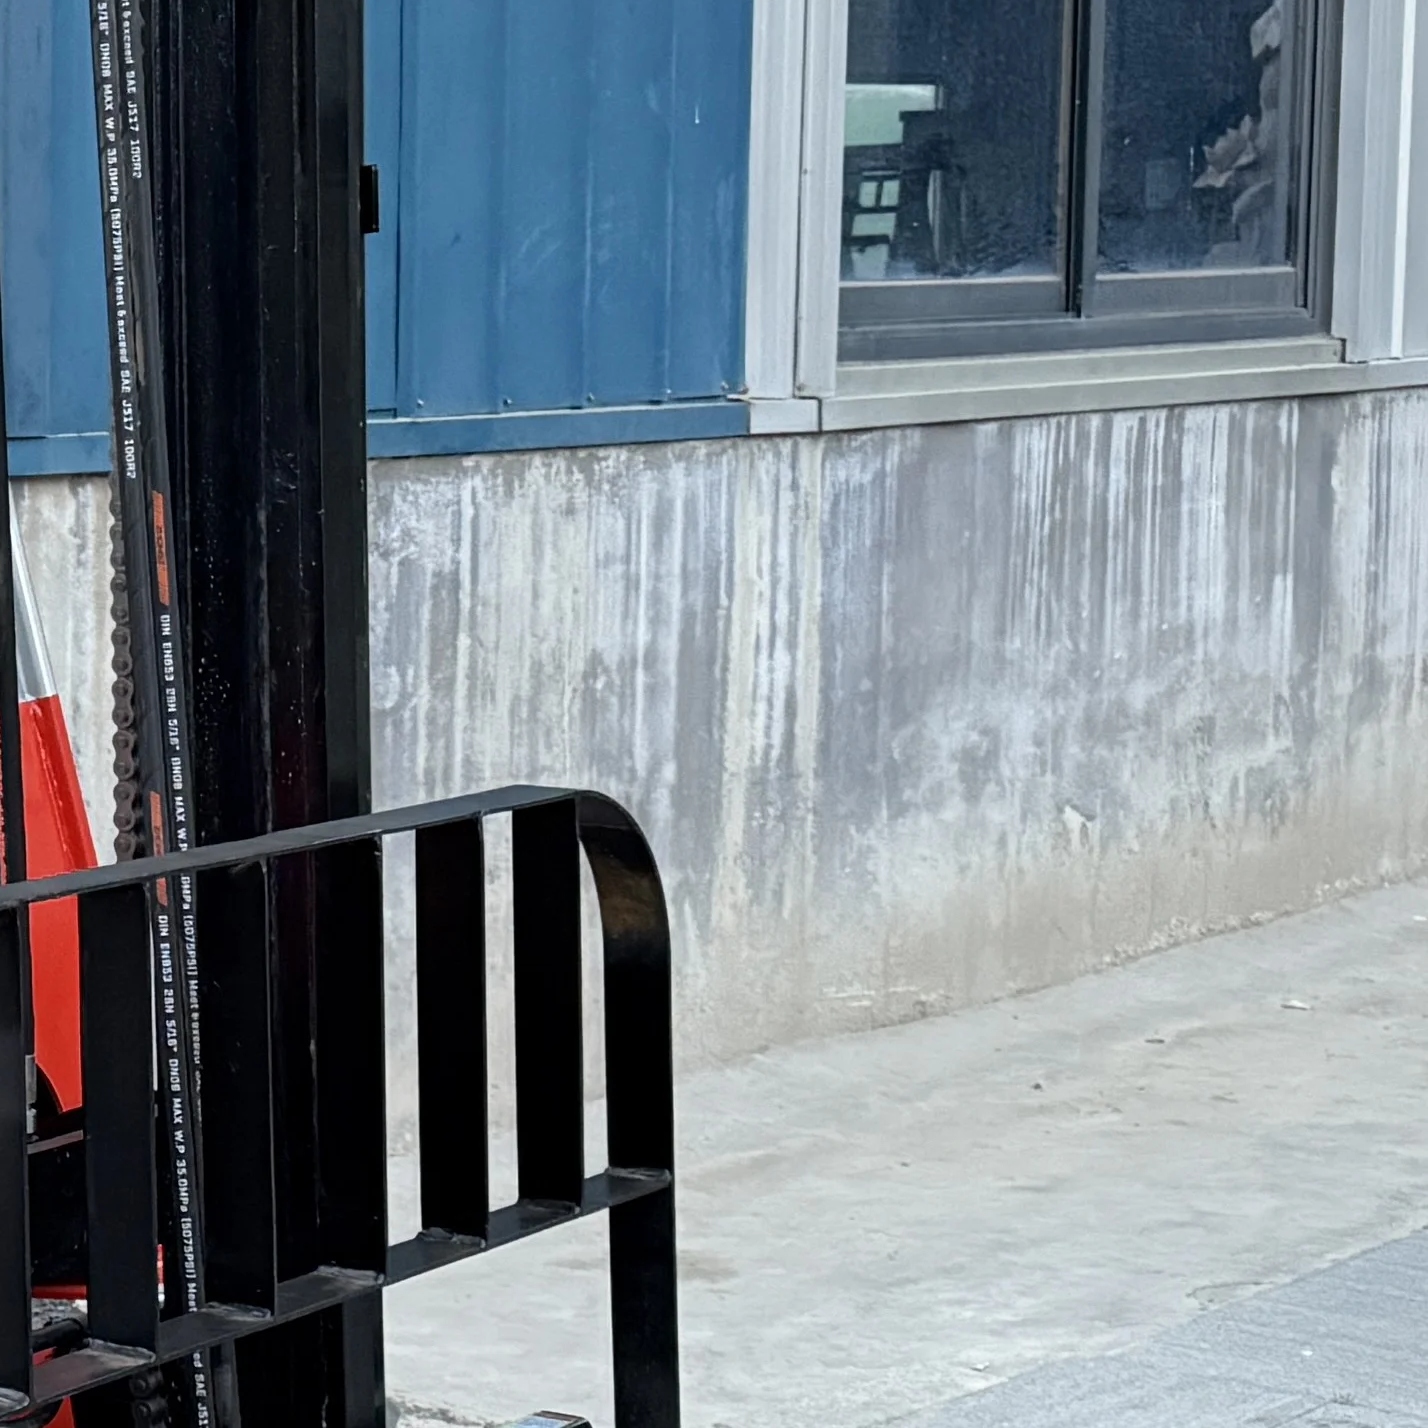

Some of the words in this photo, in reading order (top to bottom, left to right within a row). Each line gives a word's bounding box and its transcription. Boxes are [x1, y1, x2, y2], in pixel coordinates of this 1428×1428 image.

[104, 84, 113, 110] MAX
[126, 71, 136, 93] SAE
[128, 101, 139, 131] J517
[131, 140, 141, 178] 100R2
[121, 370, 131, 392] SAE
[123, 400, 133, 431] J517
[125, 439, 136, 478] 100R2
[161, 615, 171, 635] DIN
[175, 797, 185, 821] MAX
[159, 916, 168, 936] DIN
[173, 1098, 182, 1123] MAX
[195, 1374, 206, 1396] SAE
